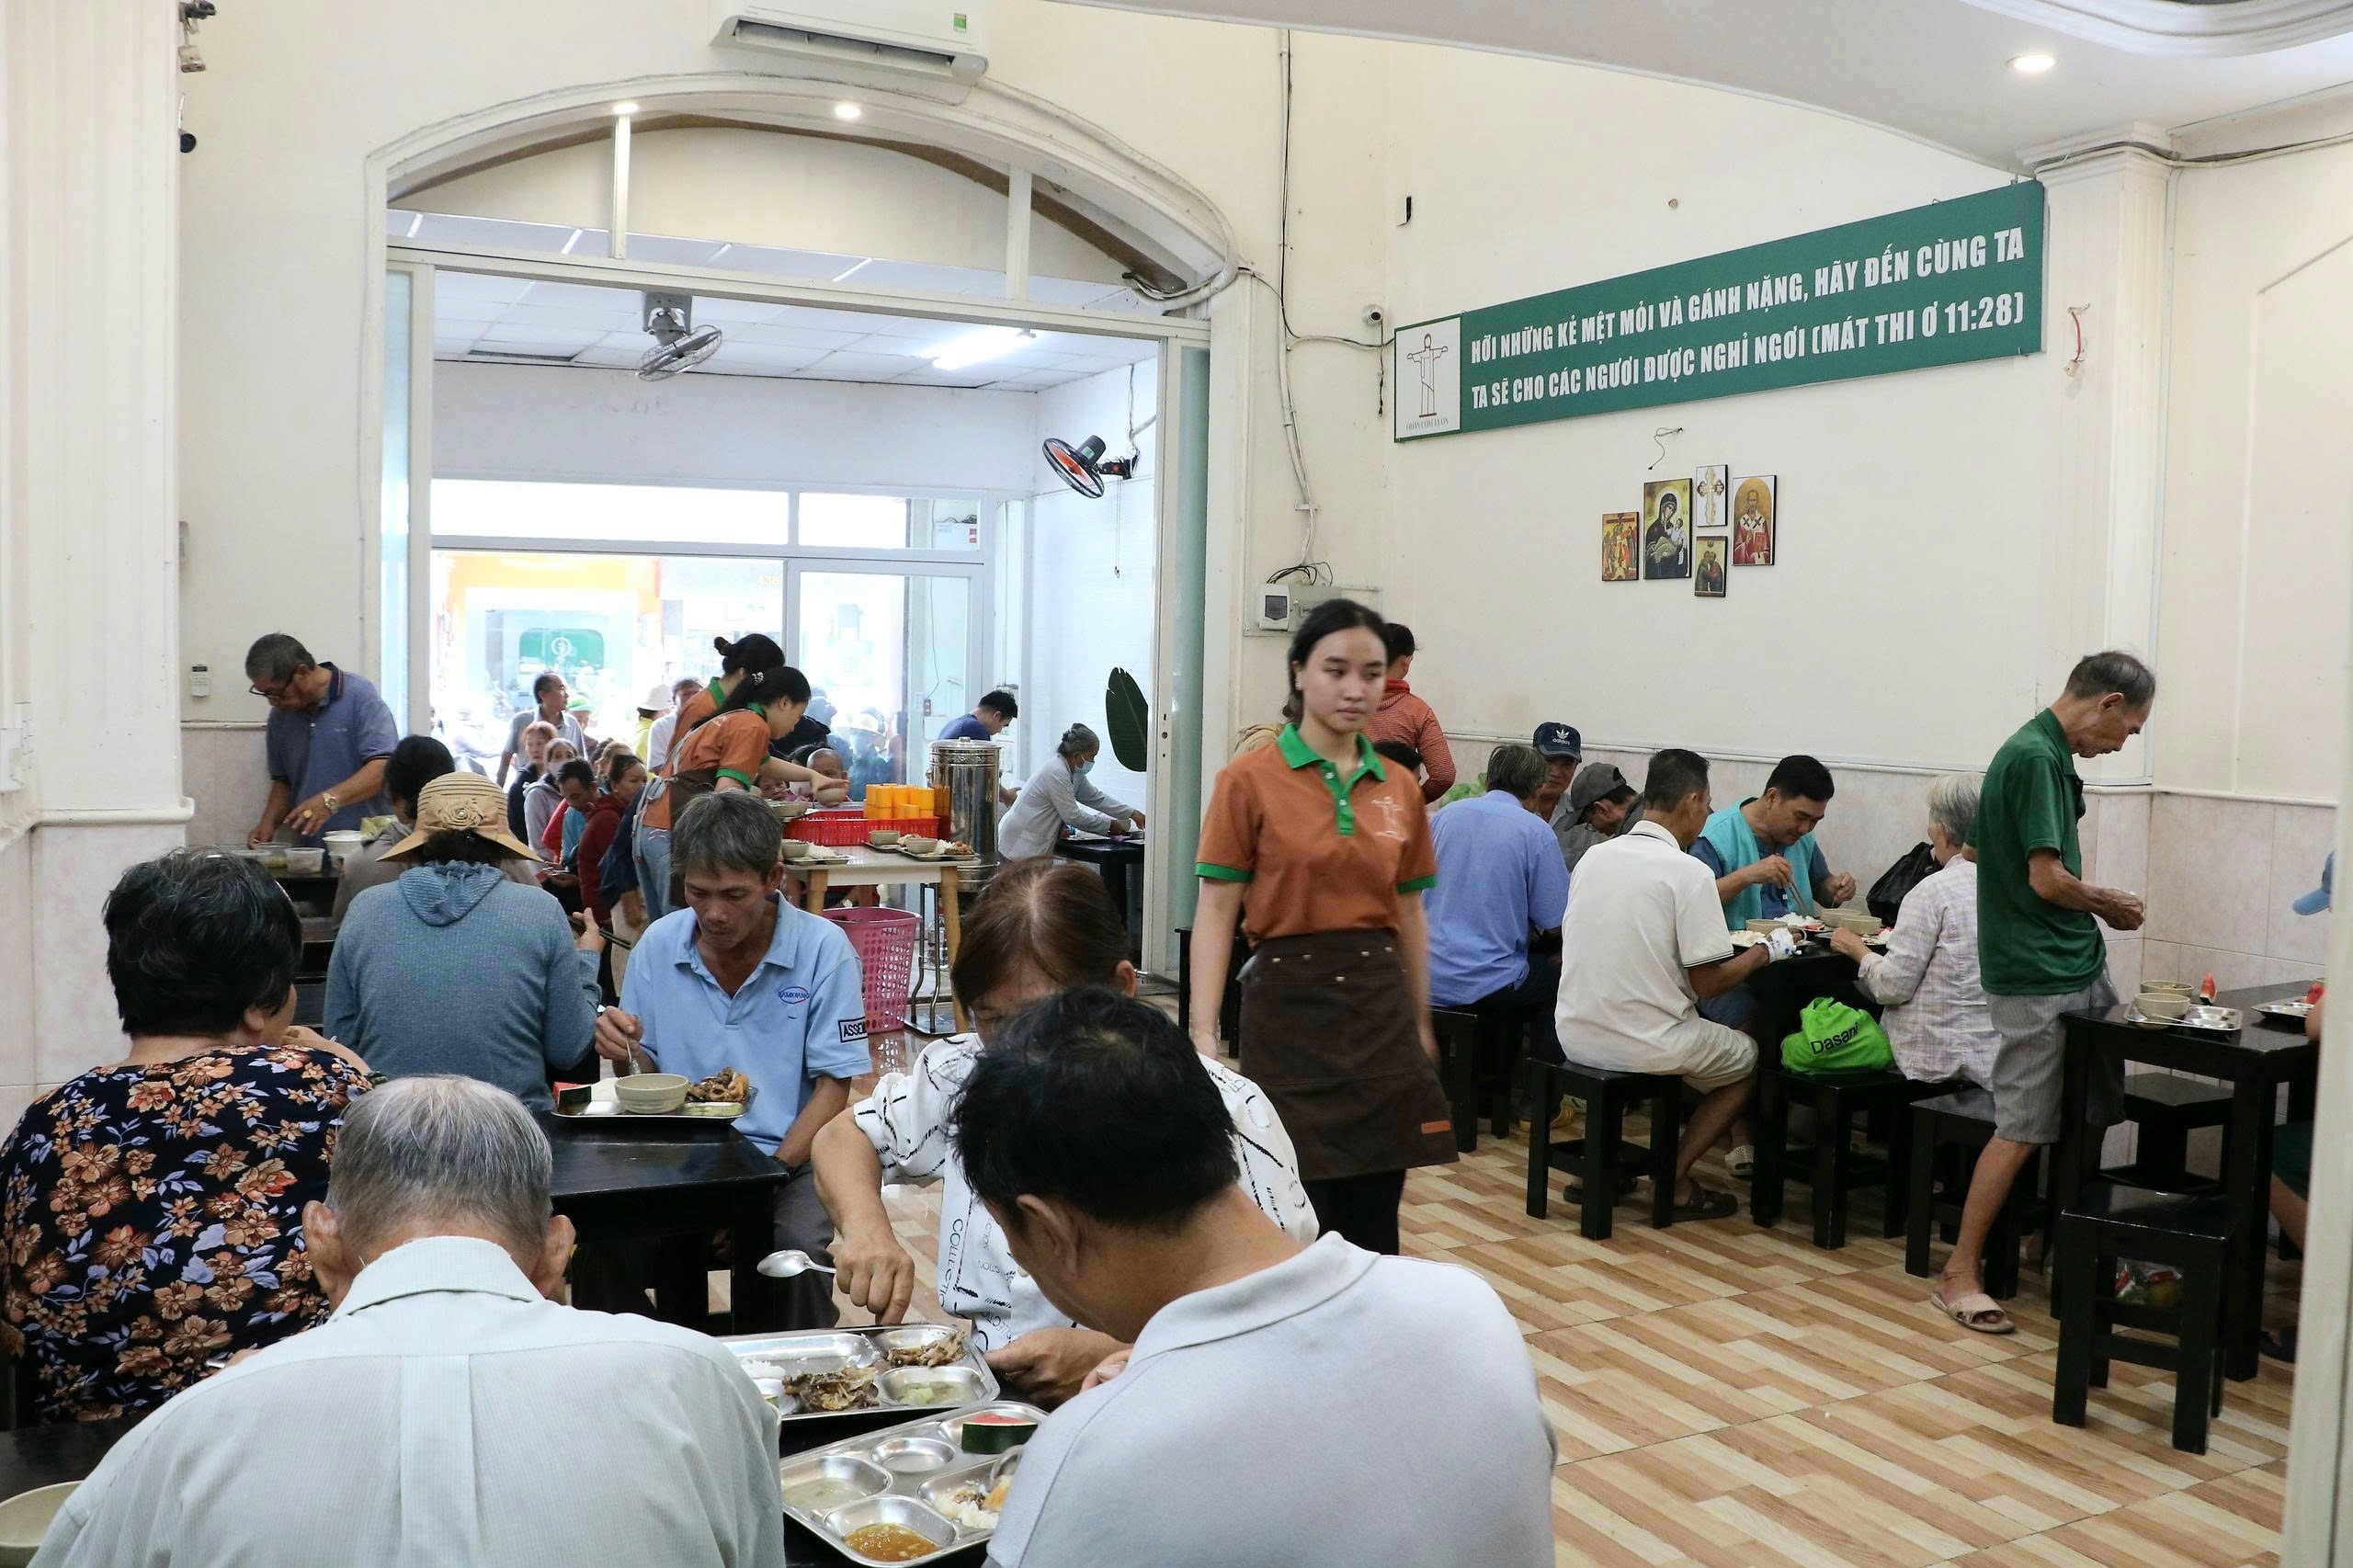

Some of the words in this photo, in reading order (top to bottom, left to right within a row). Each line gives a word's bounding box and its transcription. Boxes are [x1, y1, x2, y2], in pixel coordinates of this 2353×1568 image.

[1472, 335, 1496, 363] HỠI
[1501, 325, 1553, 358] NHỮNG
[1558, 314, 1577, 347] KẺ
[1581, 310, 1616, 345] MỆT
[1620, 301, 1654, 336] MỎI
[1658, 295, 1683, 328] VÀ
[1688, 288, 1741, 323] GÁNH
[1746, 273, 1808, 312] NẶNG,
[1815, 259, 1859, 297] HÃY
[1864, 244, 1909, 288] ĐẾN
[1916, 235, 1985, 278] CÙNG
[1994, 227, 2024, 263] TA
[1472, 385, 1488, 409] TA
[1492, 378, 1508, 406] SẼ
[1513, 375, 1544, 403] CHO
[1549, 367, 1581, 398] CÁC
[1586, 356, 1639, 392] NGƯƠI
[1643, 347, 1695, 383] ĐƯỢC
[1700, 332, 1748, 373] NGHỈ
[1755, 325, 1805, 364] NGƠI
[1812, 315, 1869, 354] (MÁT
[1875, 309, 1915, 345] THI
[1944, 291, 2024, 334] 11:28)
[1810, 1022, 1859, 1055] Dasani
